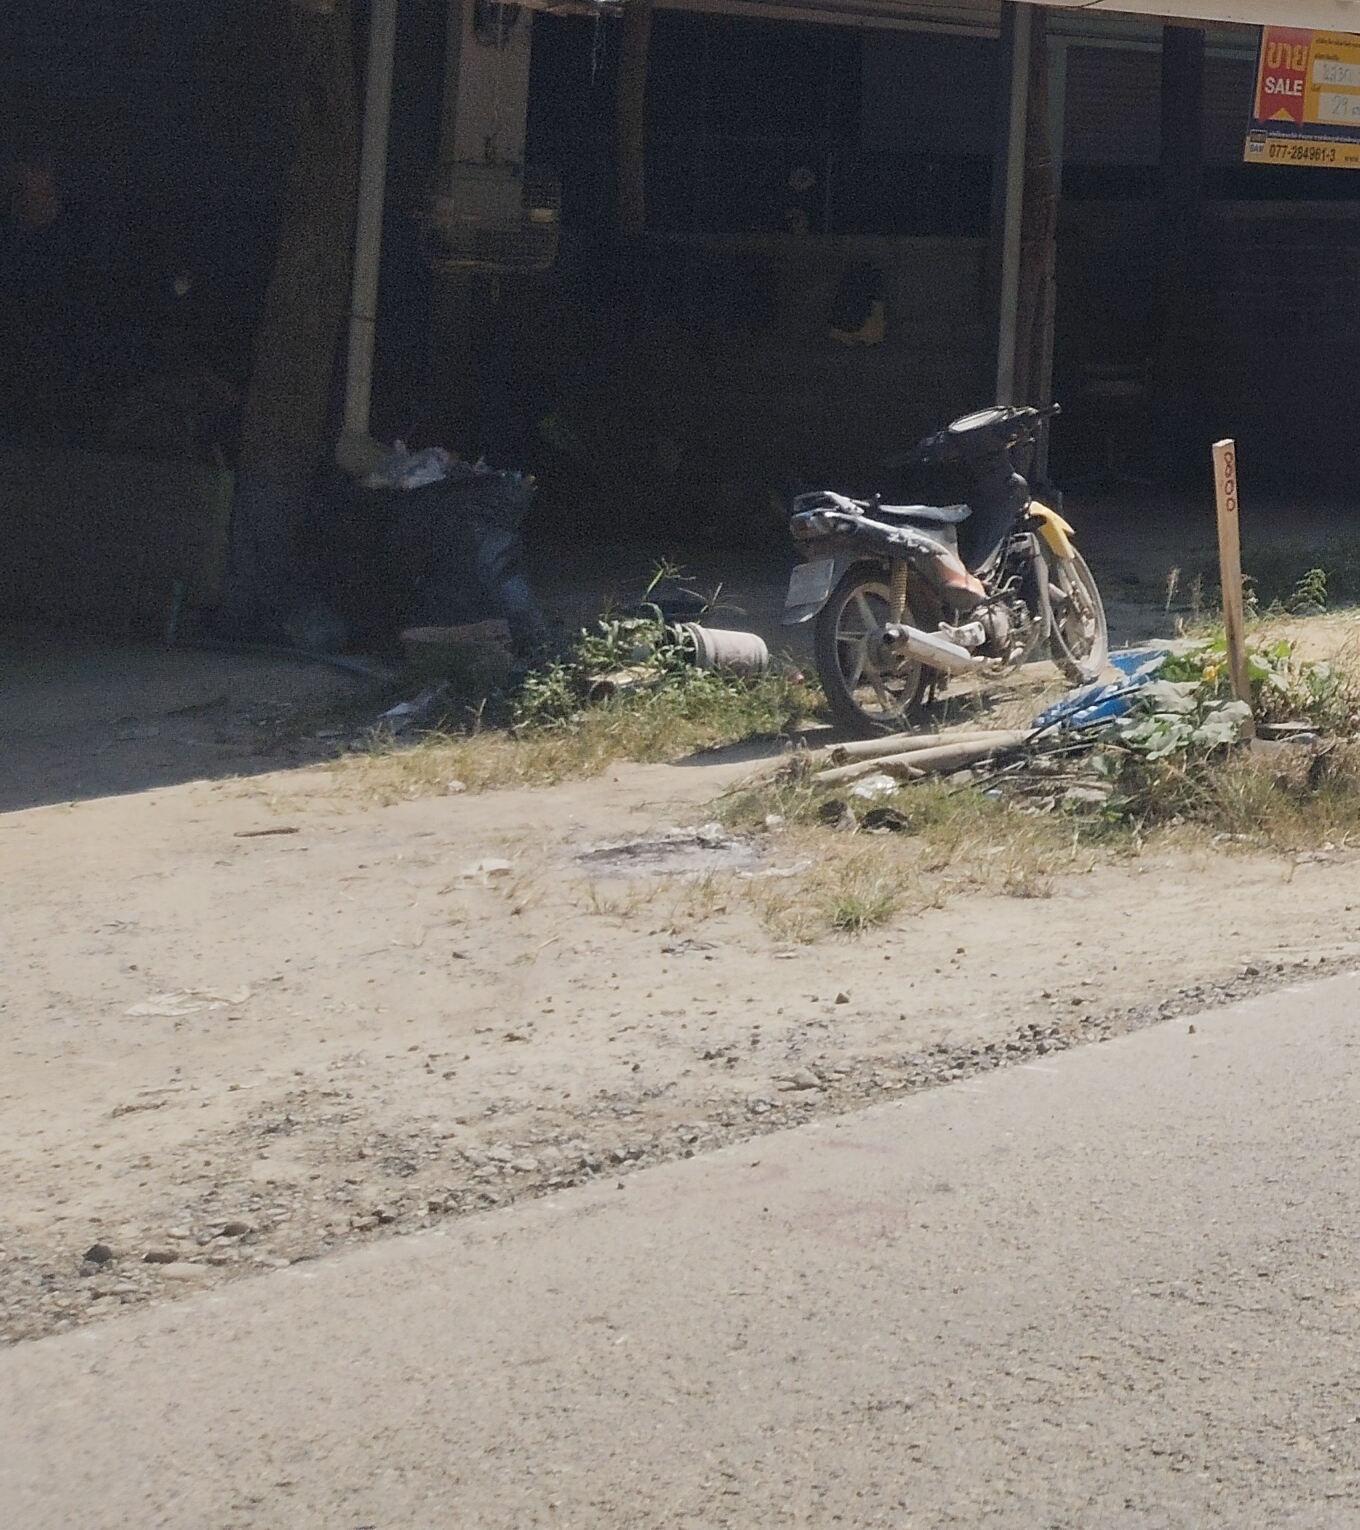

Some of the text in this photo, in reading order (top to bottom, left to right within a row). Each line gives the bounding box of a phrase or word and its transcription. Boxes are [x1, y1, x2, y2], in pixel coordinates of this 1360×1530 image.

[1267, 42, 1308, 71] ขาย
[1265, 77, 1303, 96] SALE
[1269, 144, 1336, 162] 077-284961-3
